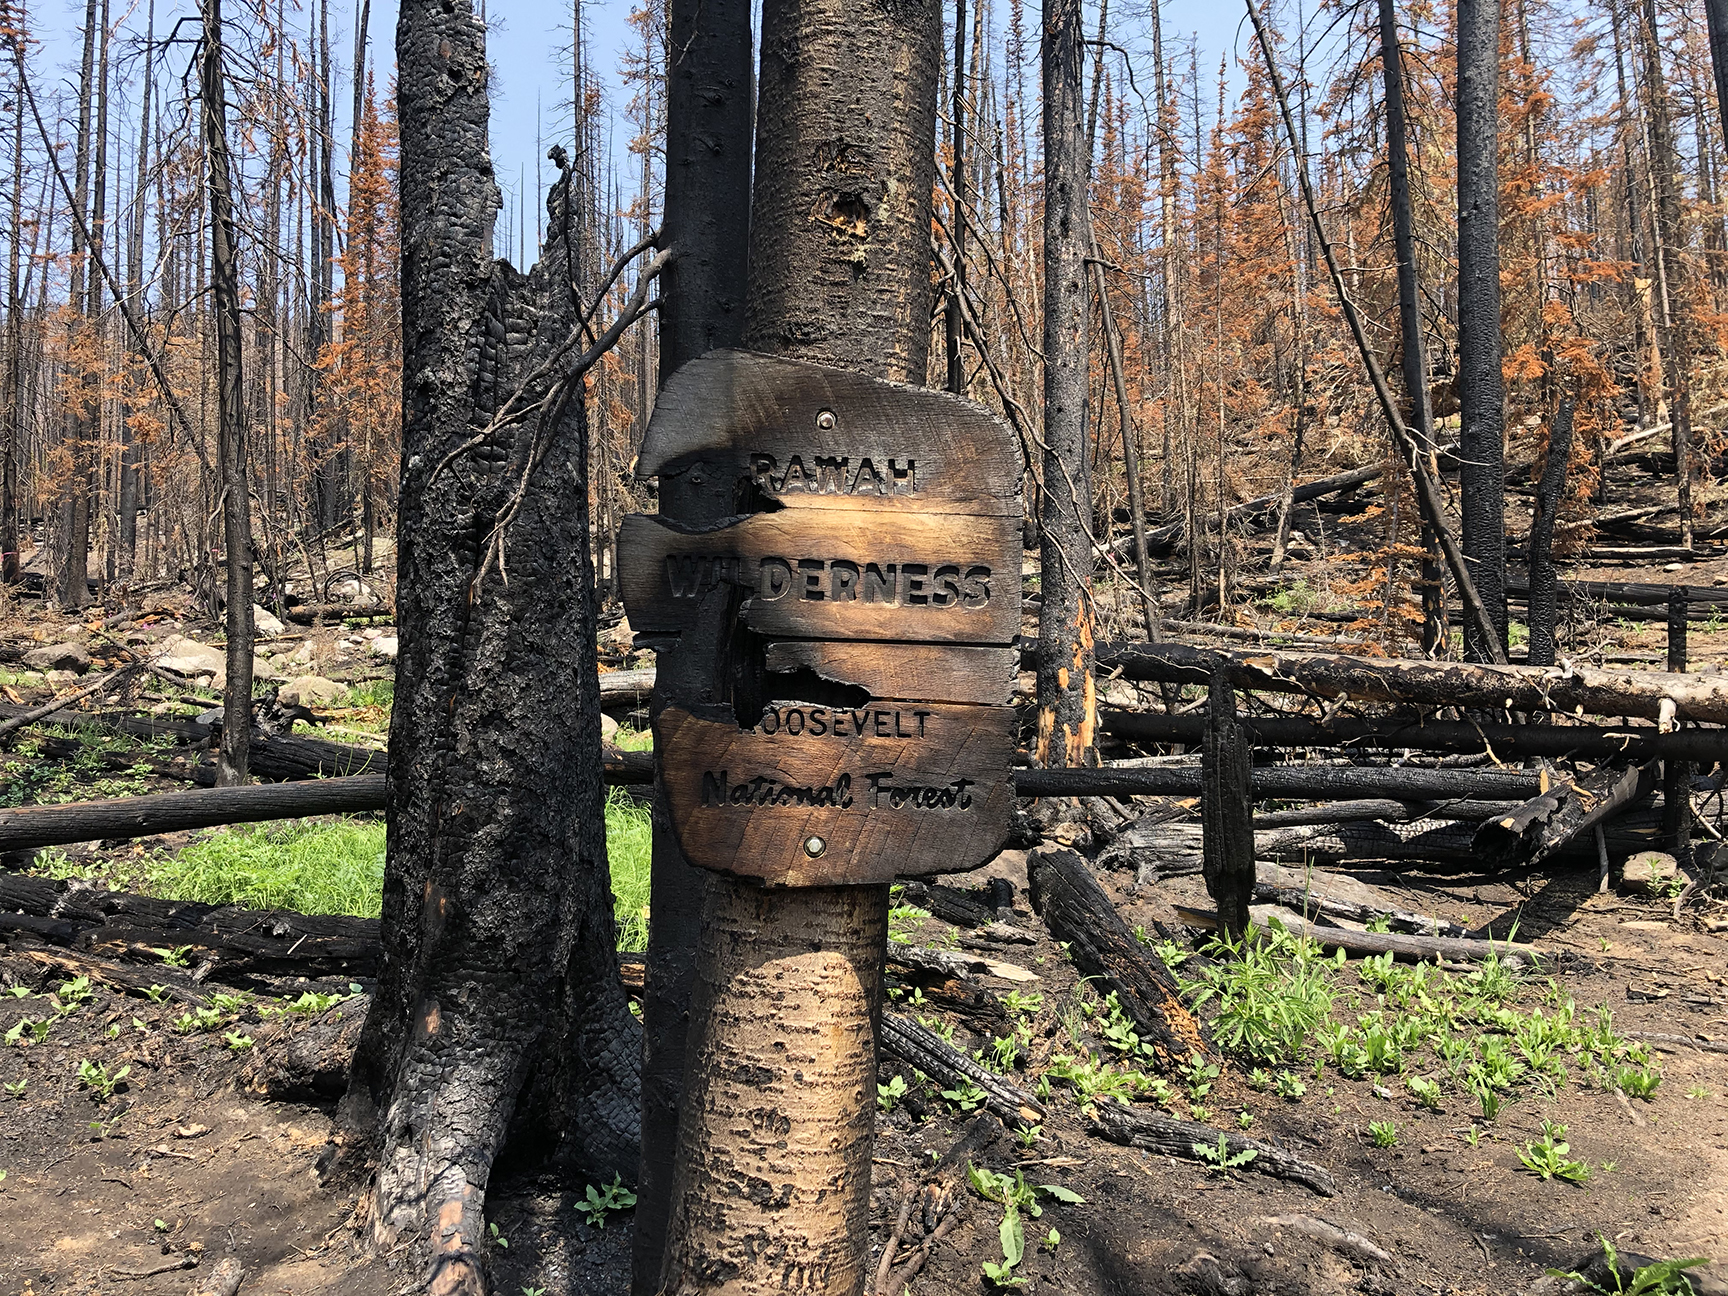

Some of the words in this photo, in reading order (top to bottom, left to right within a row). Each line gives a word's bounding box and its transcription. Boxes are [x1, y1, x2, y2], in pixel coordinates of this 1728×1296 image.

[750, 453, 917, 496] RAWAH
[738, 709, 931, 738] OOSEVELT
[701, 769, 853, 810] National
[865, 771, 976, 811] Forest
